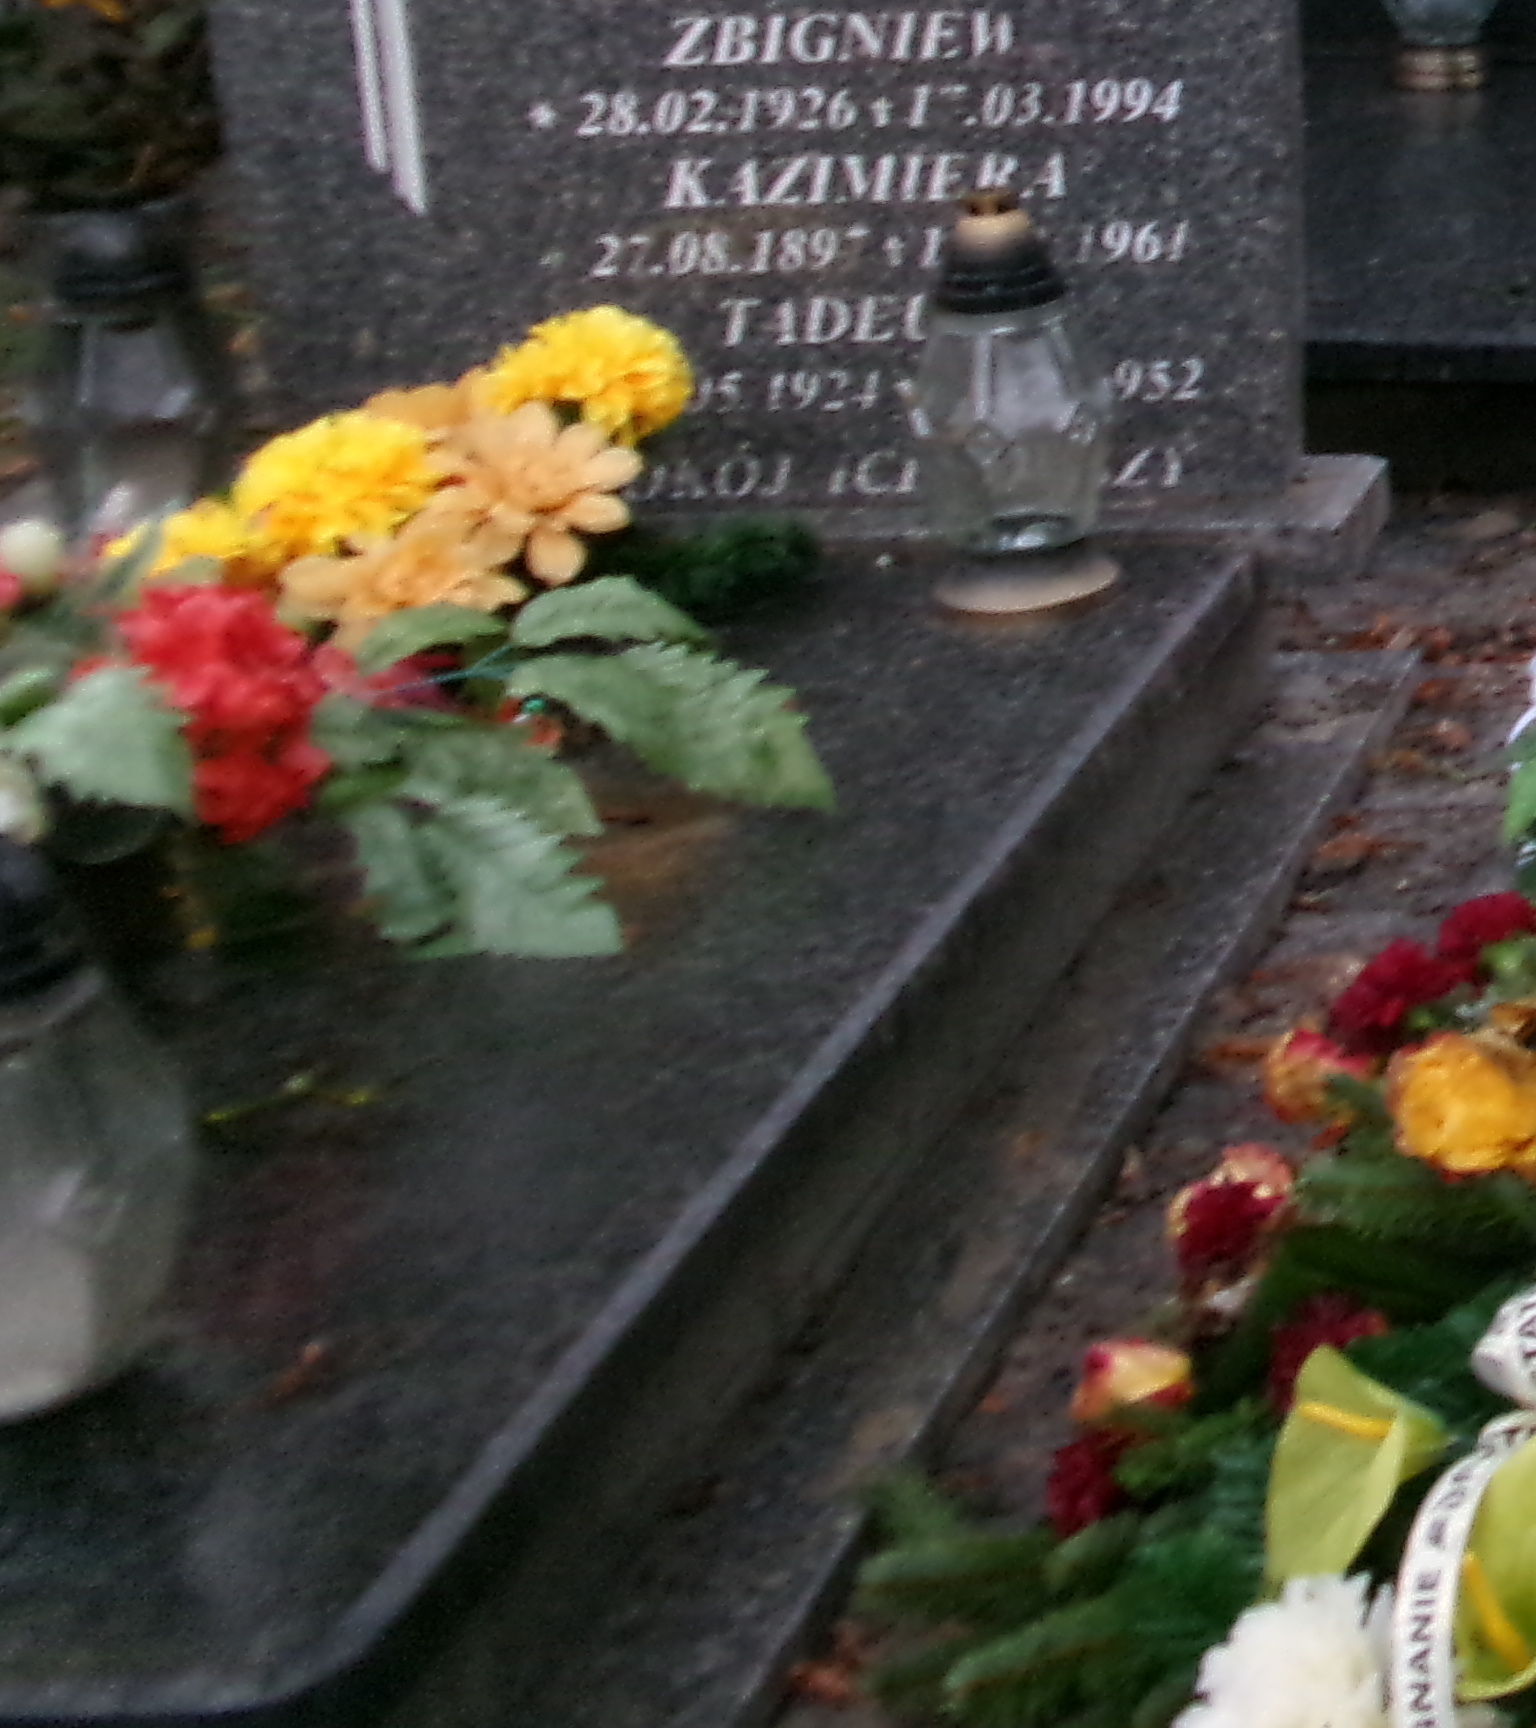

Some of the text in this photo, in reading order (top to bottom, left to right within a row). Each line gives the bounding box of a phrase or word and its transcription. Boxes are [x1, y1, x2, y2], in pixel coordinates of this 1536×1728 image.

[662, 9, 1015, 67] ZBIGNIEW
[577, 87, 857, 138] 28.02.1926
[664, 151, 1068, 209] KAZIMIERA
